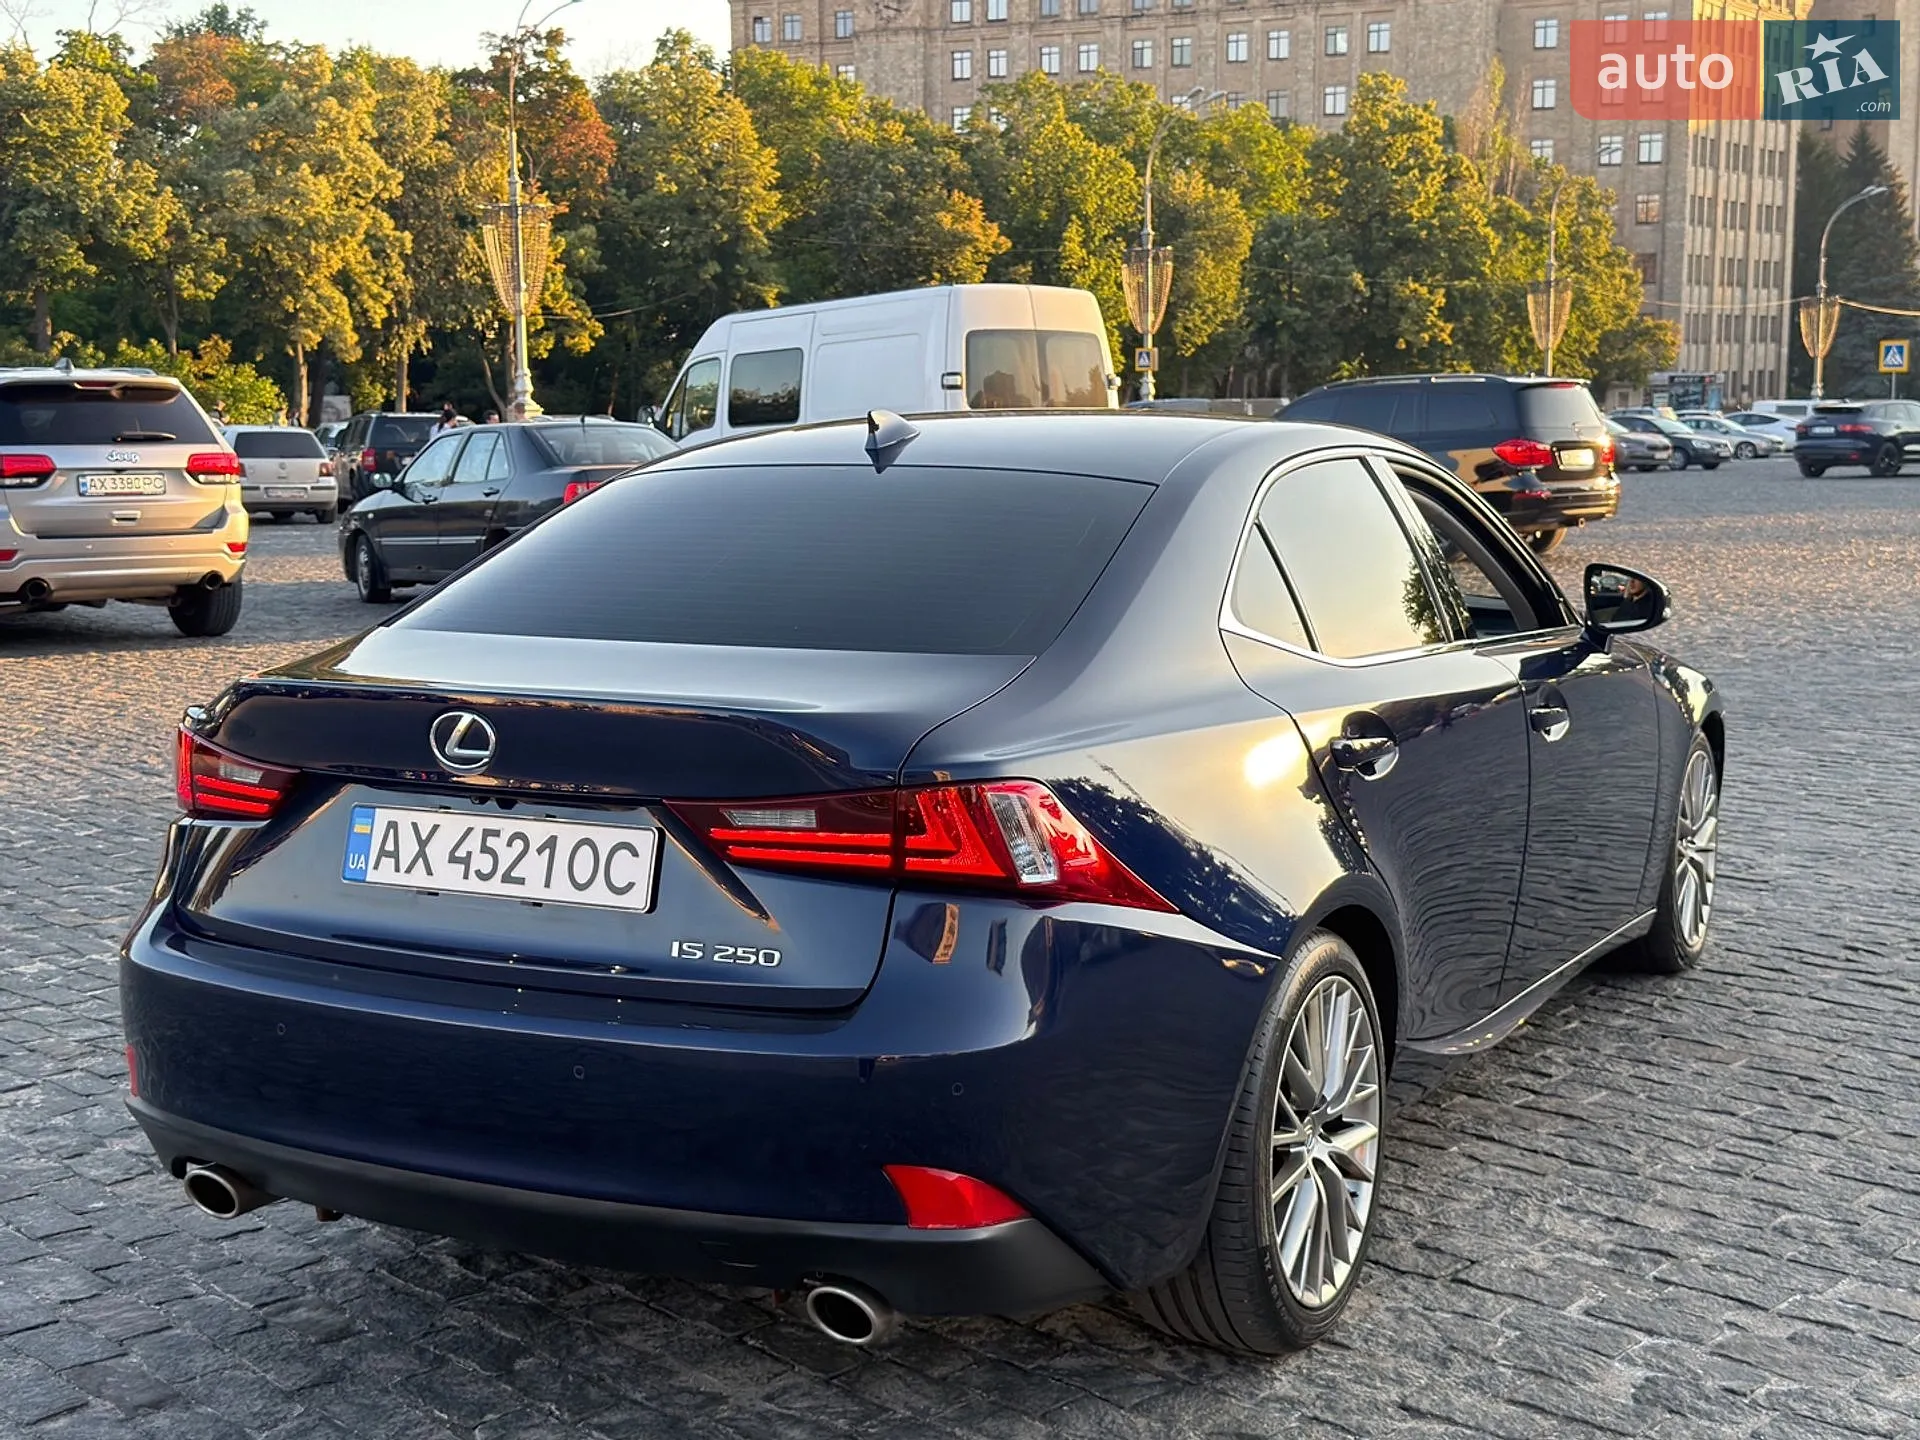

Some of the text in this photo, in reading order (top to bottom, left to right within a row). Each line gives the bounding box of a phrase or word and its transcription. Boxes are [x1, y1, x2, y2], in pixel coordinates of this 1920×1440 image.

[107, 450, 140, 463] Jeep
[89, 478, 107, 490] AX
[373, 820, 440, 876] AX
[349, 853, 366, 870] UA
[671, 940, 781, 967] IS 250
